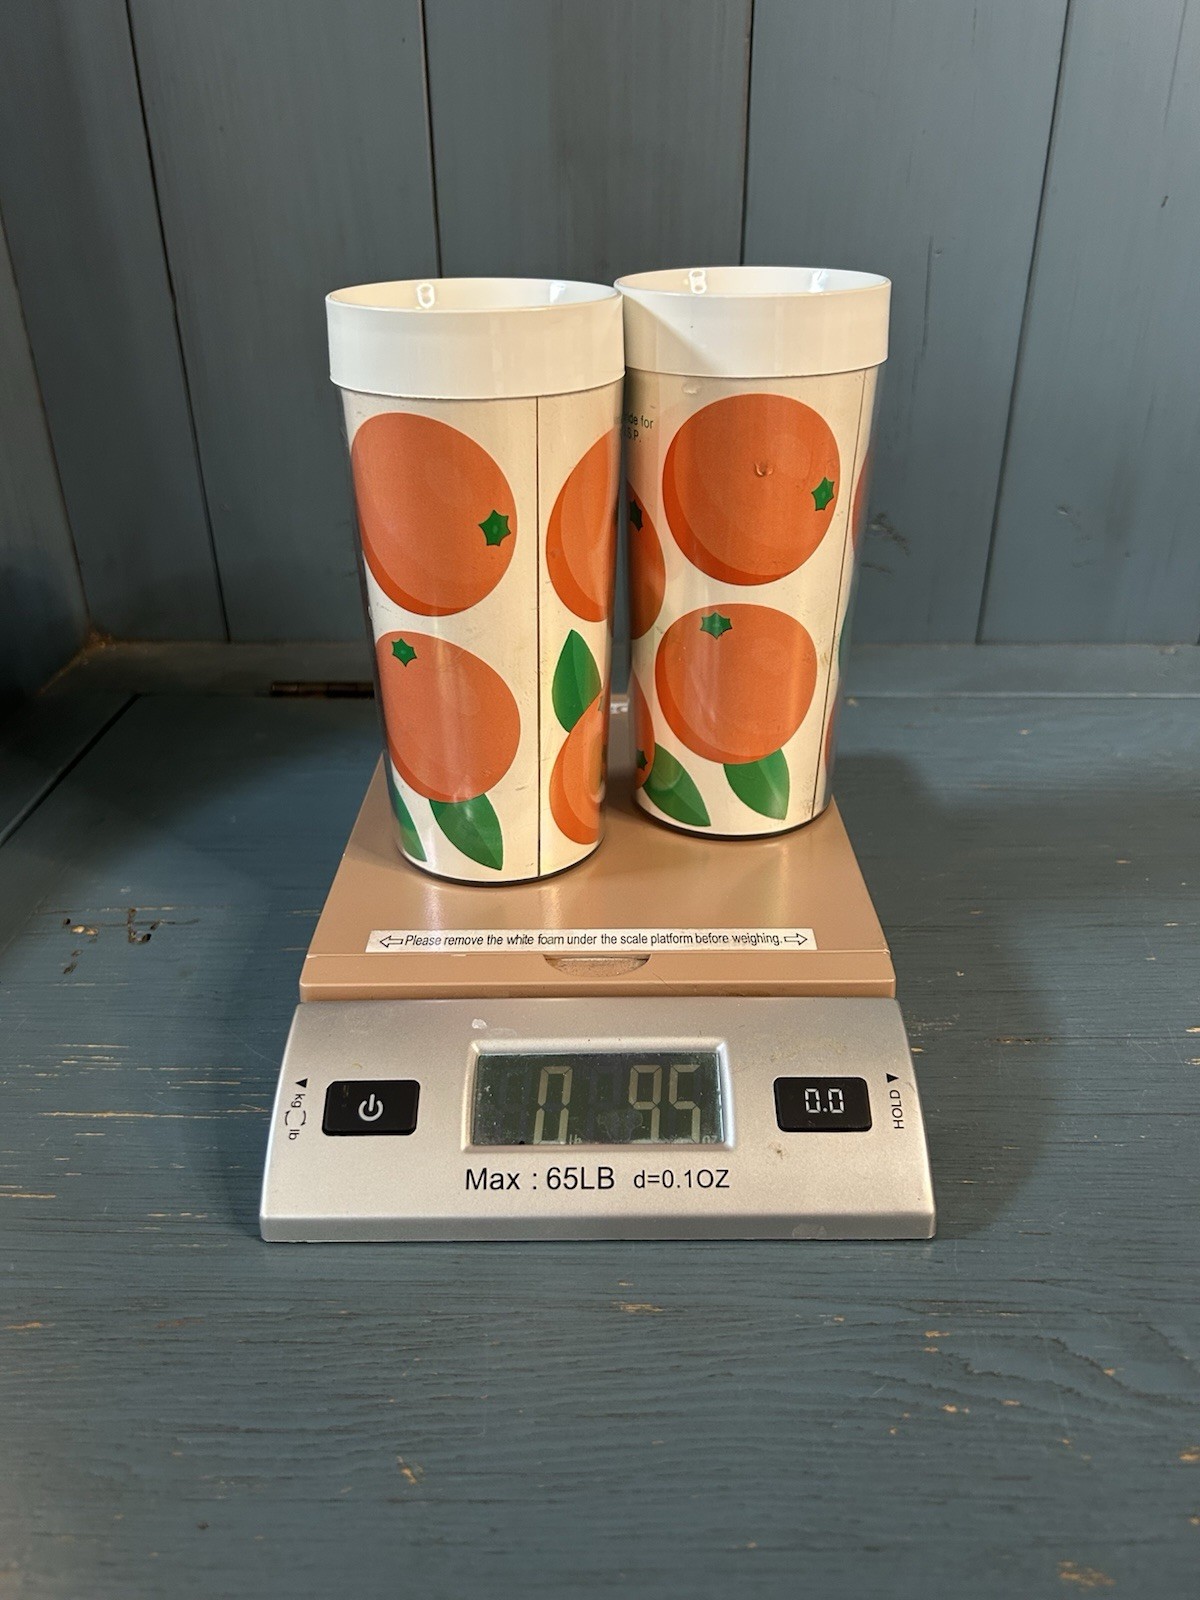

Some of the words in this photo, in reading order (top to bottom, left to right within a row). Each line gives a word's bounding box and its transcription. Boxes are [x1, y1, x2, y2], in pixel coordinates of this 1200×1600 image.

[640, 415, 654, 429] for
[404, 934, 442, 946] Please
[443, 935, 484, 946] remove
[486, 934, 503, 945] the
[507, 933, 534, 945] white
[537, 933, 564, 945] foam
[566, 933, 597, 945] under
[600, 933, 617, 944] the
[620, 932, 648, 944] scale
[650, 933, 693, 946] platform
[695, 932, 729, 944] before
[732, 932, 783, 946] weighing.
[290, 1093, 306, 1108] kg
[804, 1087, 845, 1114] 0.0
[889, 1089, 905, 1130] HOLD
[288, 1128, 300, 1141] lb
[465, 1167, 521, 1190] Max
[546, 1166, 615, 1190] 65LB
[633, 1169, 730, 1189] d=0.1OZ
